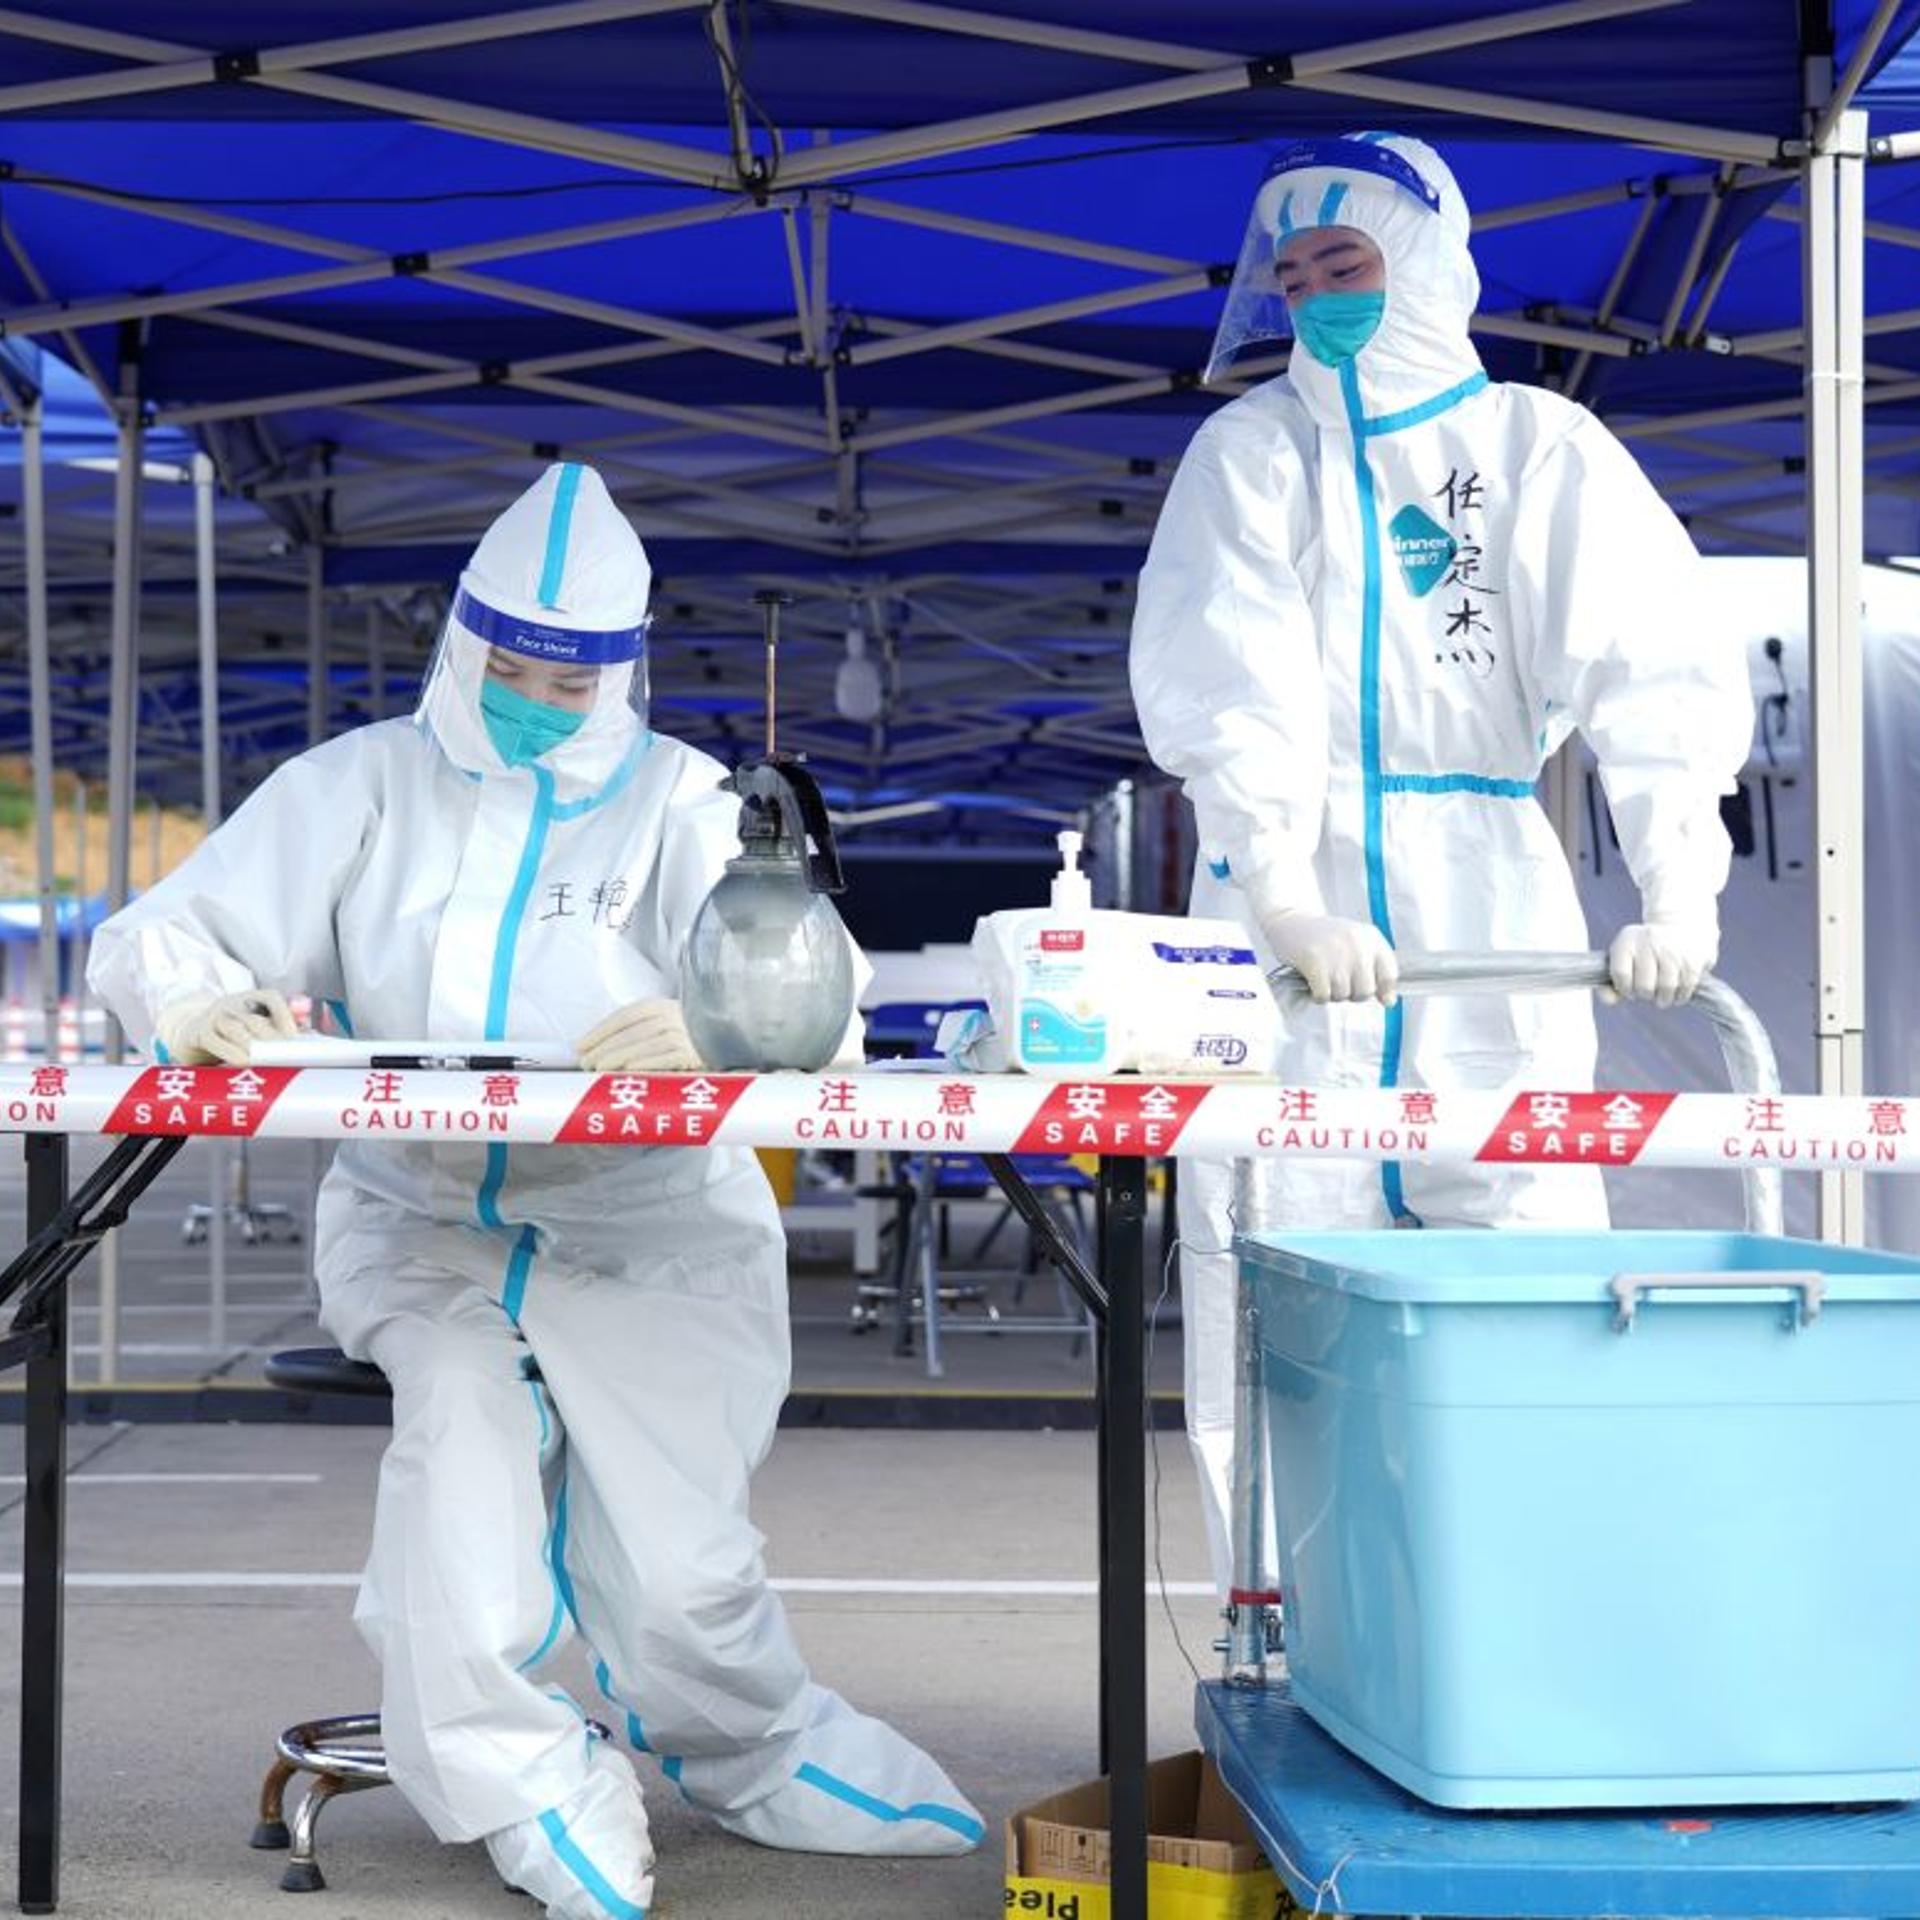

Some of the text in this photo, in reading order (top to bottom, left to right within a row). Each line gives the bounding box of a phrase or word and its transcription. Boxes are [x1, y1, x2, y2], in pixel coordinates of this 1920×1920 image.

[0, 1101, 57, 1122] ON
[135, 1103, 249, 1127] SAFE
[341, 1108, 509, 1132] CAUTION
[587, 1112, 704, 1137] SAFE
[796, 1117, 966, 1142] CAUTION
[1045, 1121, 1163, 1146] SAFE
[1257, 1126, 1428, 1151] CAUTION
[1509, 1131, 1627, 1156] SAFE
[1723, 1137, 1897, 1162] CAUTION
